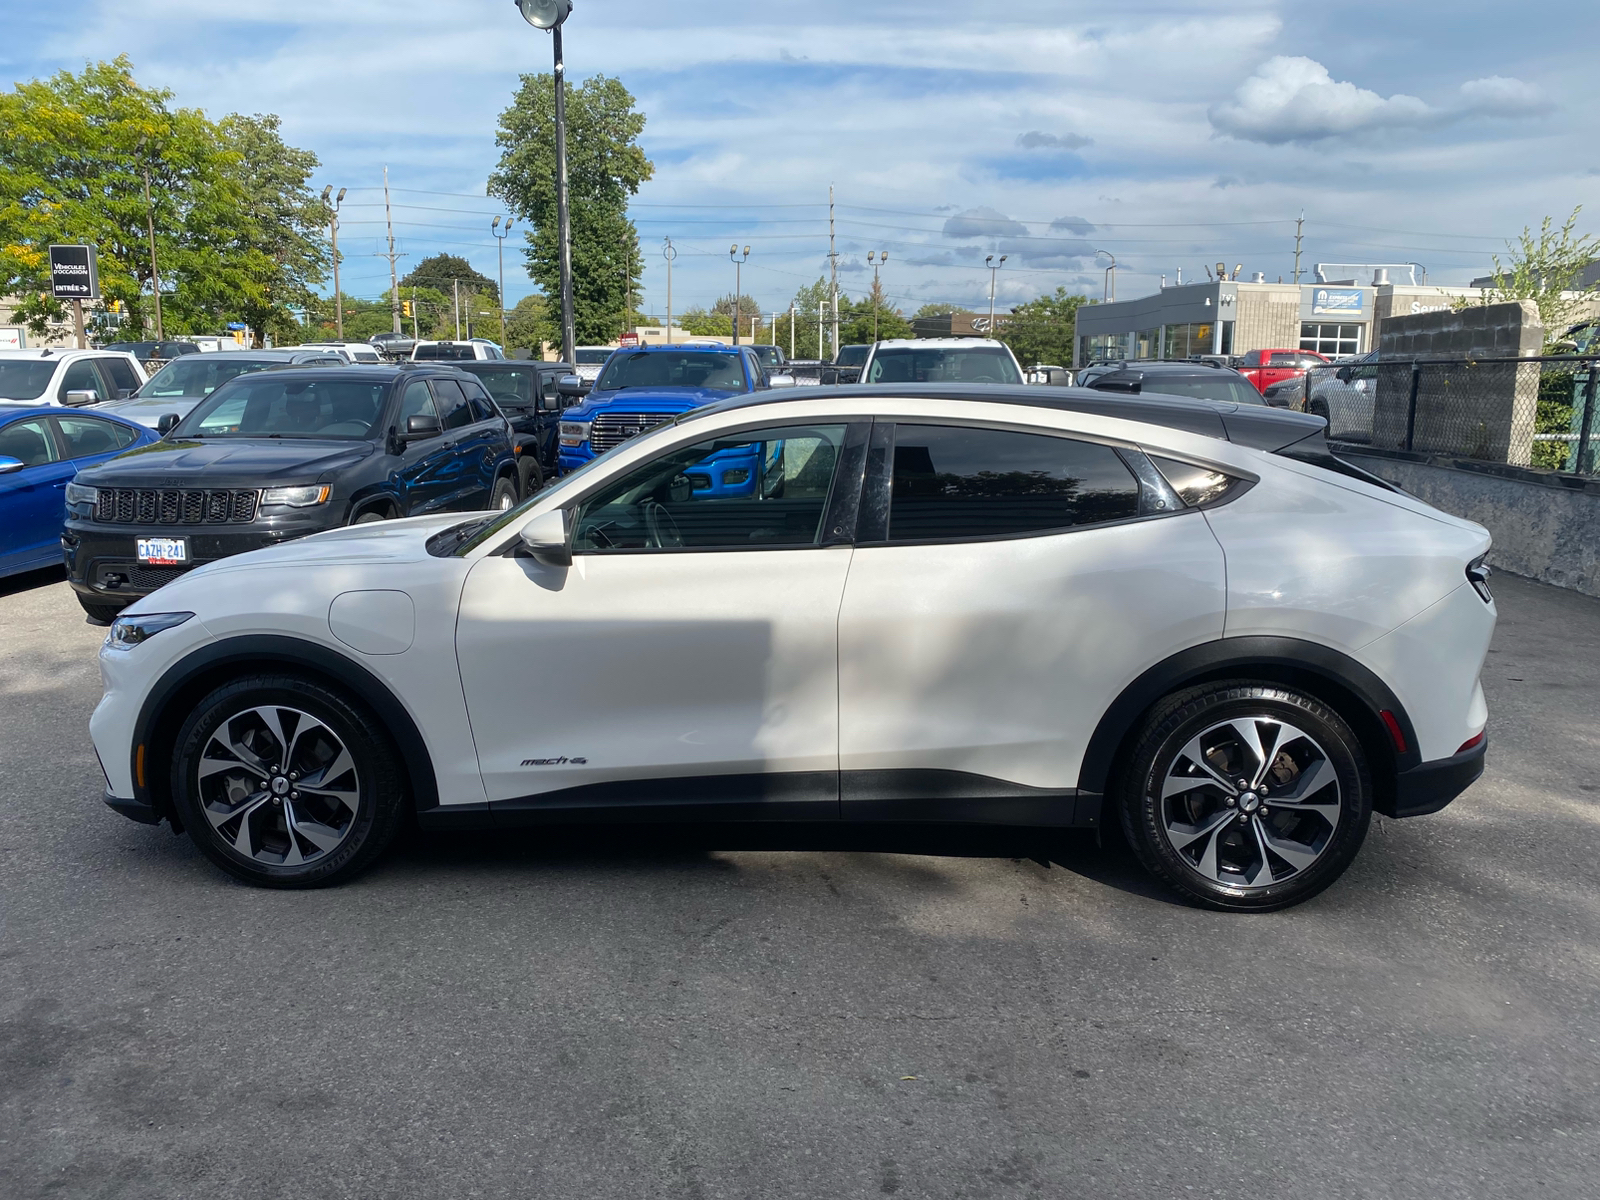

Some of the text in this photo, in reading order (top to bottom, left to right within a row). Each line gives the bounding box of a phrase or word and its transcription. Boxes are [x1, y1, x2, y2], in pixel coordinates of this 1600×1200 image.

[55, 284, 80, 292] ENTRÉE
[160, 477, 185, 487] Jeep
[138, 544, 184, 558] CAZH 241
[314, 836, 361, 874] MICHELIN
